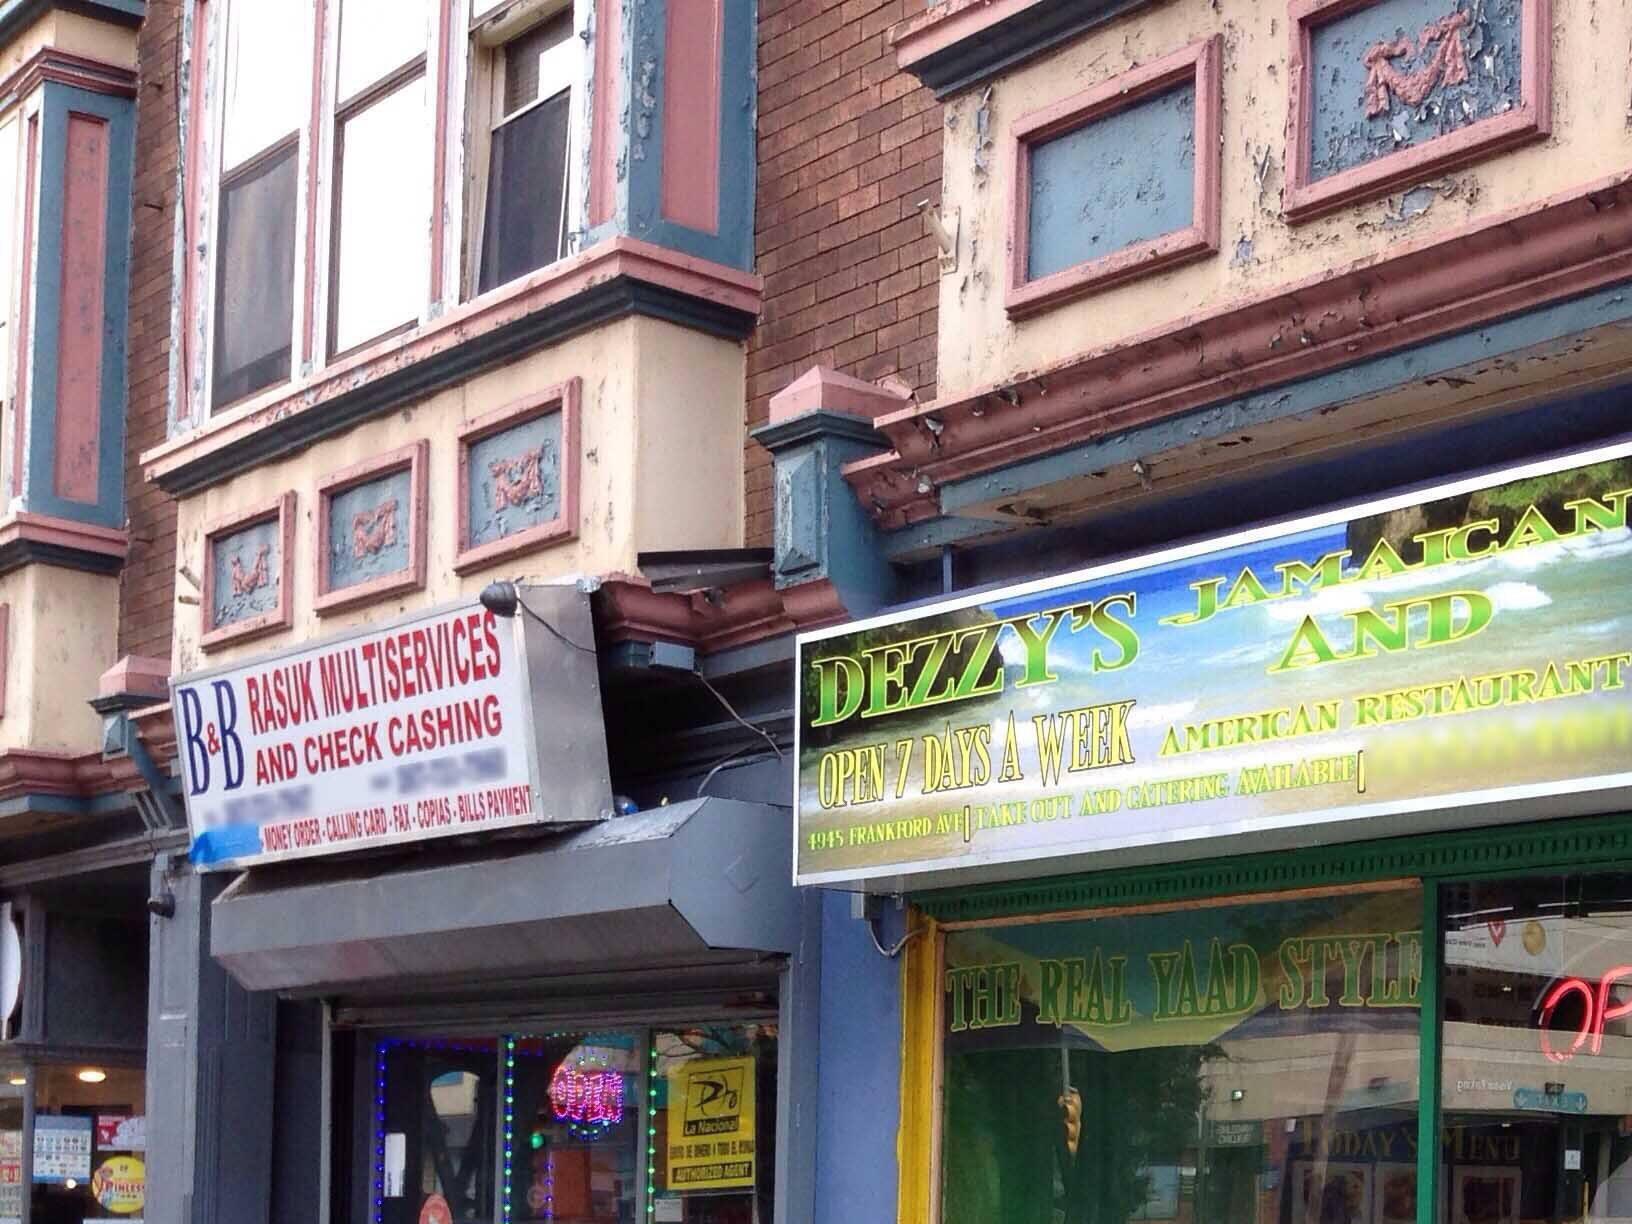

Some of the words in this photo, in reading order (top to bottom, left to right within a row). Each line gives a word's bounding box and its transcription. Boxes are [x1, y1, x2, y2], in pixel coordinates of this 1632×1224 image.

[246, 660, 320, 736] RASUK
[320, 610, 501, 717] MULTISERVICES
[811, 592, 1141, 728] DEZZY'S
[1267, 589, 1494, 674] AND
[255, 741, 299, 787] AND
[304, 721, 383, 775] CHECK
[388, 694, 503, 756] CASHING
[817, 742, 888, 810] OPEN
[894, 738, 916, 799] 7
[922, 720, 992, 794] DAYS
[998, 709, 1024, 782] A
[1033, 699, 1137, 788] WEEK
[1160, 702, 1339, 757] AMERICAN
[1354, 652, 1632, 728] RESTAURANT
[264, 823, 292, 851] MONEY
[293, 819, 322, 848] ORDER
[326, 812, 363, 842] CALLING
[363, 807, 387, 836] CARD
[392, 804, 412, 831] FAX
[417, 797, 451, 829] COPIAS
[458, 791, 486, 823] BILLS
[487, 784, 533, 819] PAYMENT
[807, 831, 845, 851] 4945
[849, 816, 932, 847] FRANKFORD
[975, 802, 1027, 830] TAKE
[1030, 795, 1073, 823] OUT
[1079, 785, 1122, 816] AND
[1126, 771, 1230, 811] CATERING
[1236, 754, 1357, 796] AVAILABLE
[945, 963, 1023, 1032] THE
[1035, 945, 1134, 1028] REAL
[1147, 937, 1262, 1024] YAAD
[1278, 931, 1422, 1010] STYLE
